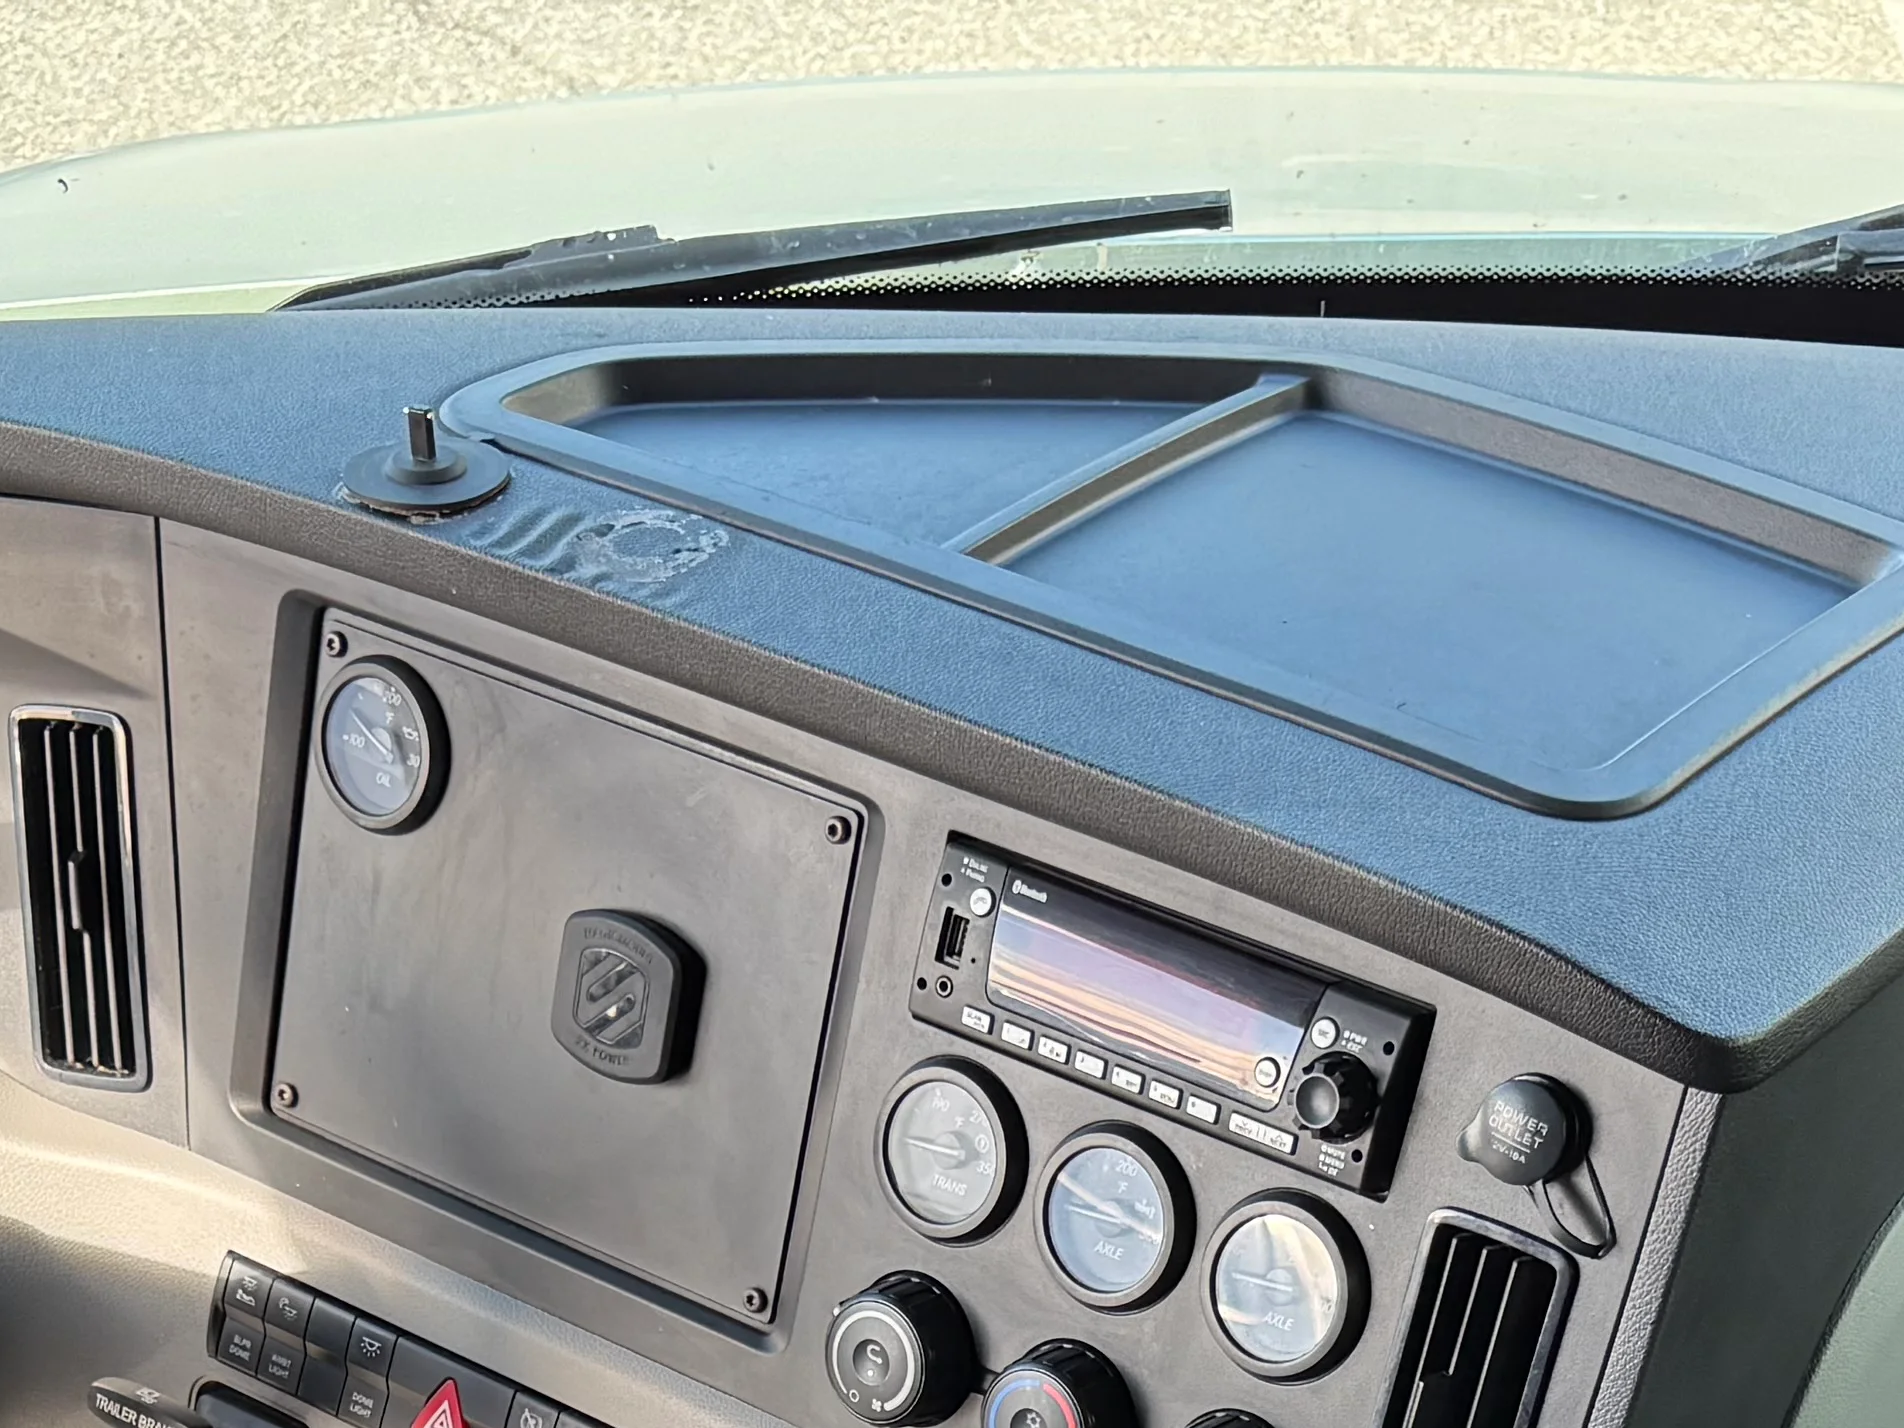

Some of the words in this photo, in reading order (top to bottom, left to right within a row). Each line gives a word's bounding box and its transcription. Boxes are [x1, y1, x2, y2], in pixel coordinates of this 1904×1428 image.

[1494, 1101, 1548, 1136] POWER
[1488, 1115, 1543, 1149] OUTLET
[1491, 1140, 1526, 1164] 2V-10A
[1115, 1160, 1138, 1177] 200
[932, 1174, 967, 1196] TRANS
[1094, 1240, 1125, 1261] AXLE
[1262, 1311, 1294, 1331] AXLE
[268, 1364, 289, 1379] LIGHT
[96, 1392, 137, 1426] TRAILER
[350, 1403, 371, 1419] LIGHT
